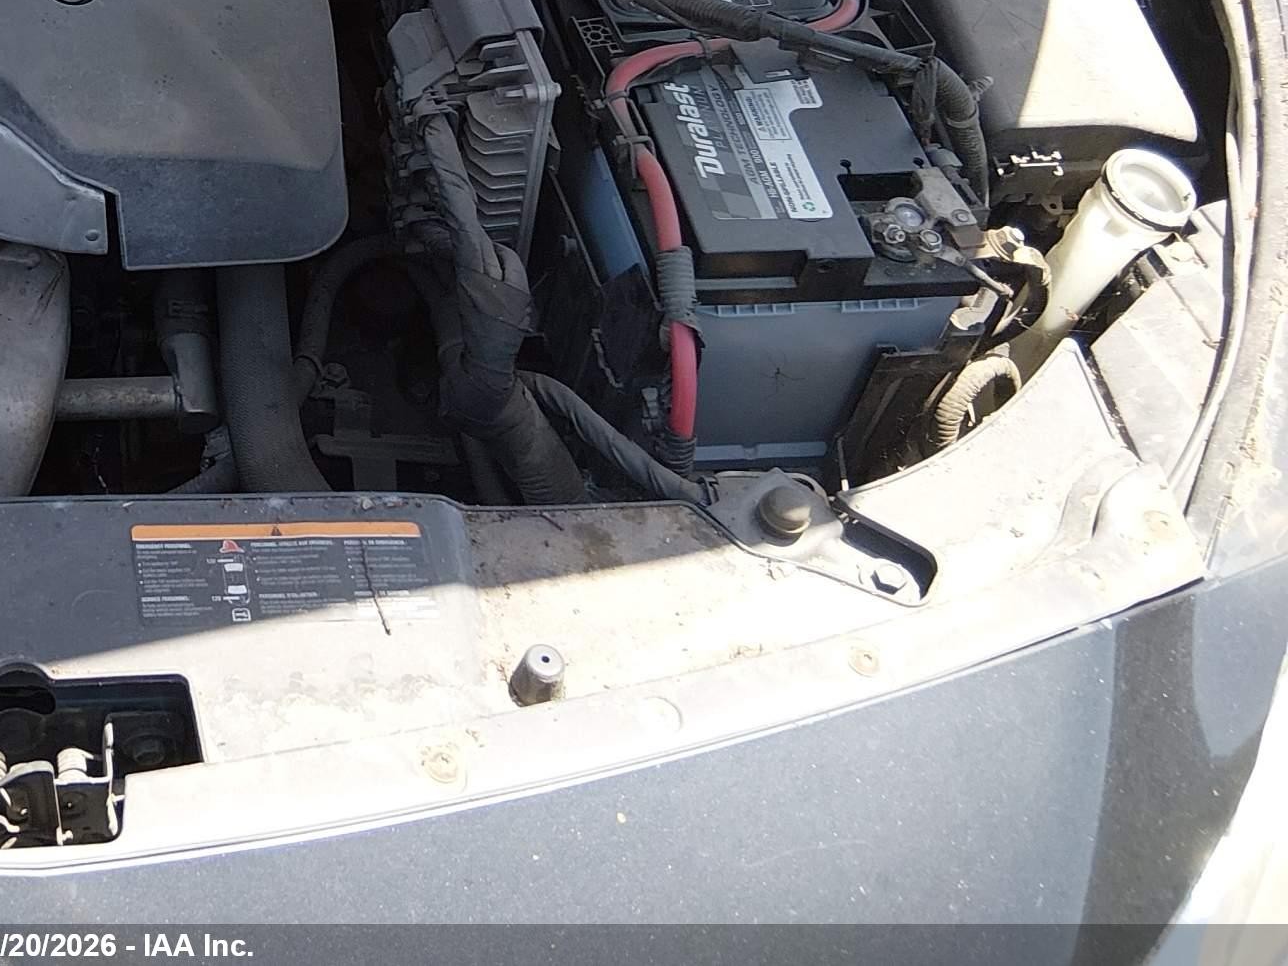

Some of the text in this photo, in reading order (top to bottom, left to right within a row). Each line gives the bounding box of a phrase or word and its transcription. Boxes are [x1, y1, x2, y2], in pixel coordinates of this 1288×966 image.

[664, 82, 726, 179] Duralast
[708, 84, 746, 154] TECHNOLOGY
[742, 158, 763, 185] AGM
[750, 149, 764, 164] 900
